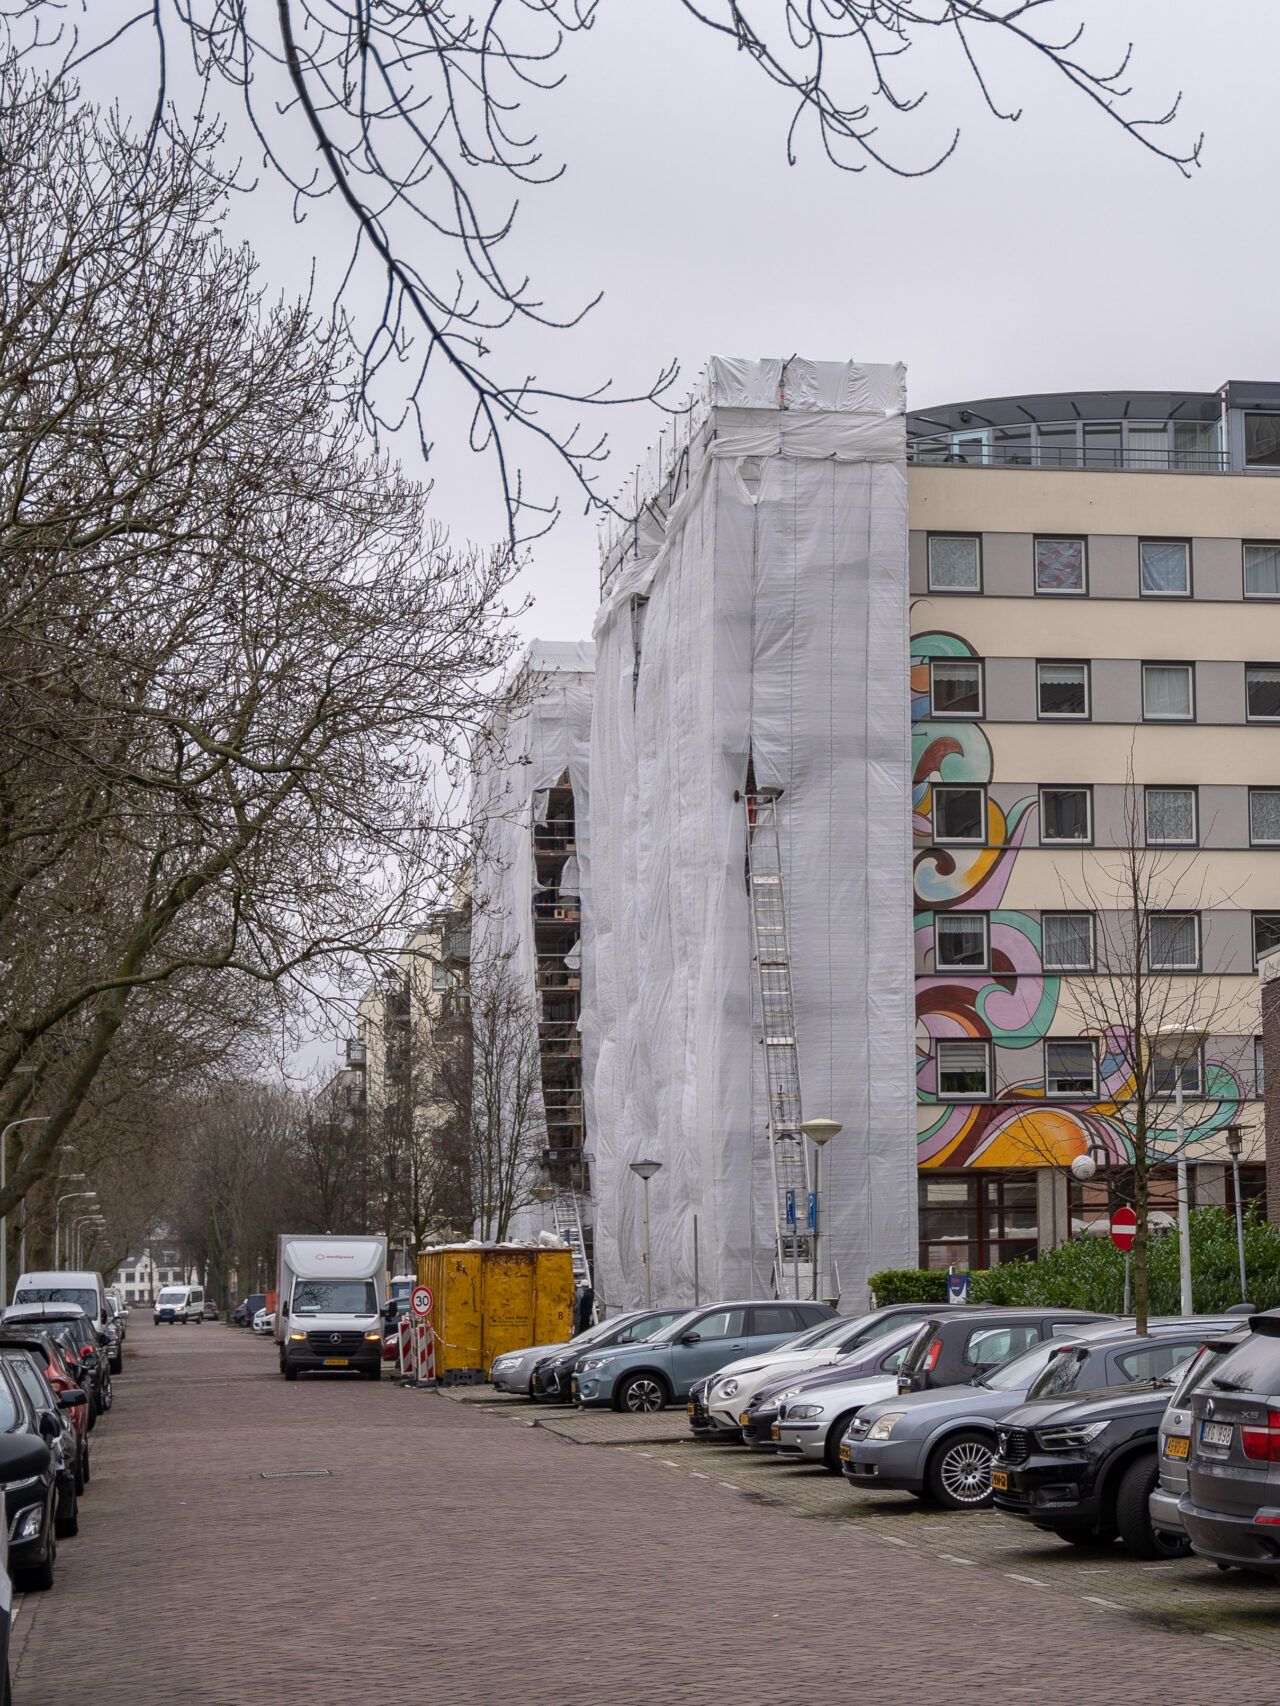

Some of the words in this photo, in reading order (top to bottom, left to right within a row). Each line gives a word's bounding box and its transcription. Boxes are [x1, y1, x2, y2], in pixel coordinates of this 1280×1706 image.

[415, 1295, 429, 1307] 30
[557, 1311, 564, 1320] 8
[1241, 1411, 1259, 1419] X5
